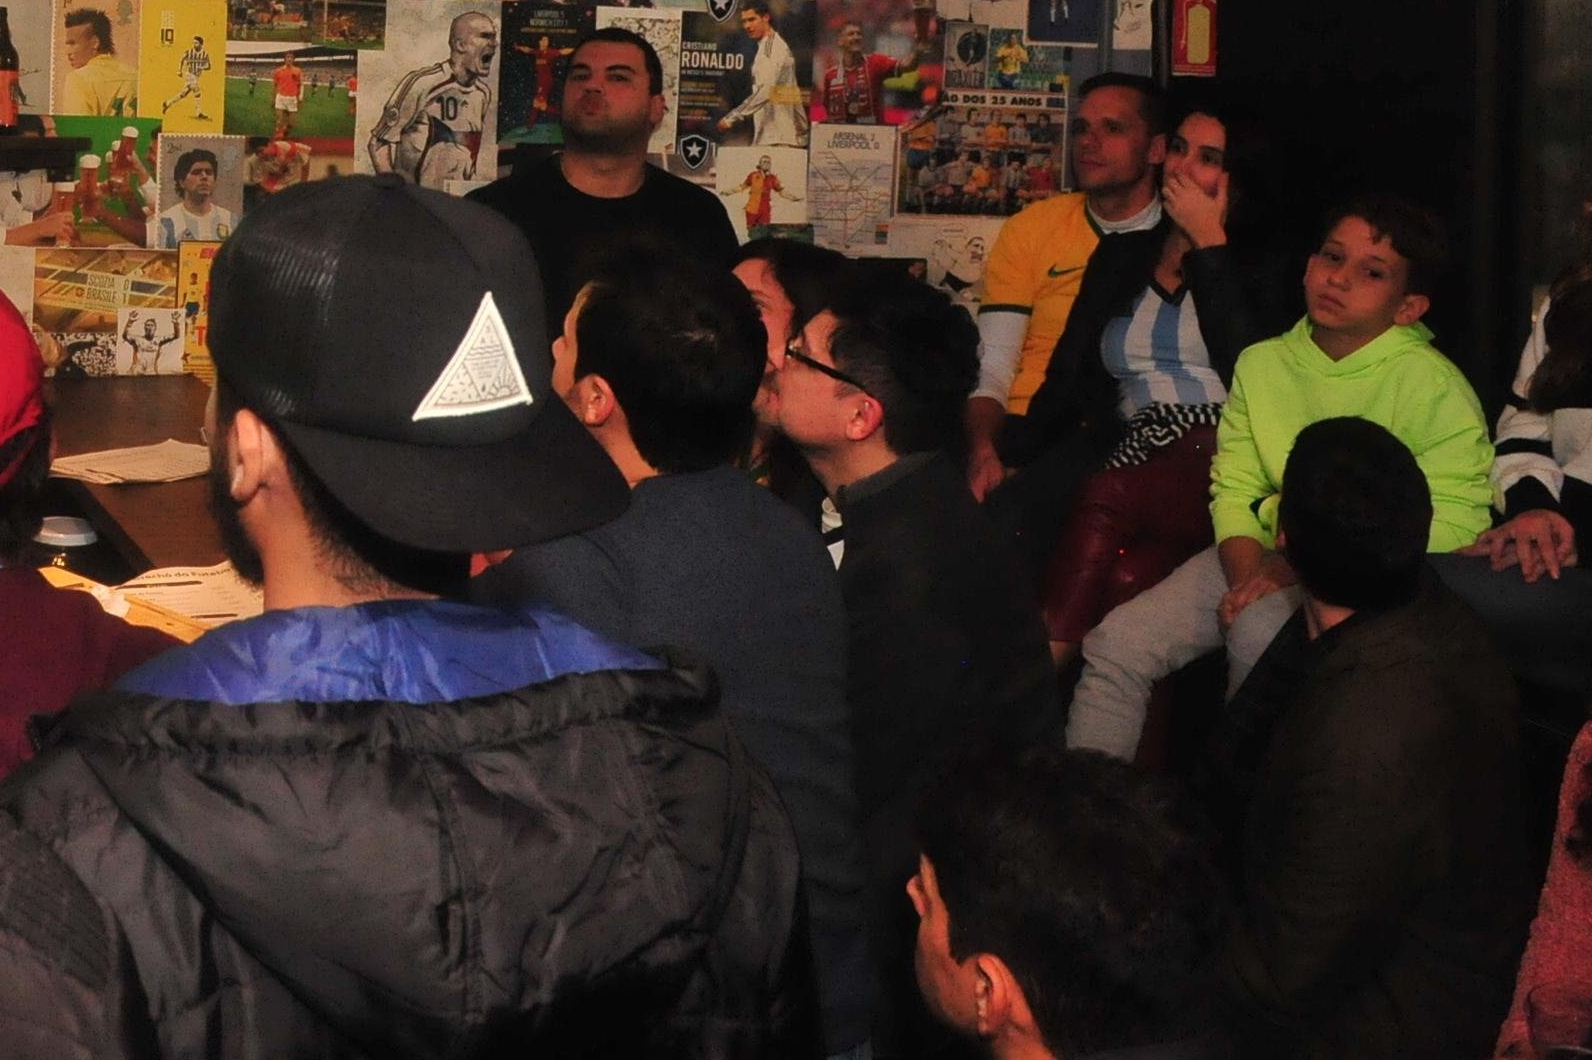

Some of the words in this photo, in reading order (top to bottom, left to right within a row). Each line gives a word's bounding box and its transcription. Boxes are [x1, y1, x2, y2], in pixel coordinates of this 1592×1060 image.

[681, 51, 744, 70] RONALDO
[435, 95, 459, 122] 10
[962, 94, 987, 104] DOS
[991, 95, 1007, 105] 25
[1010, 96, 1043, 107] ANOS
[87, 273, 116, 288] SCOZIA
[85, 286, 118, 303] BRASILE
